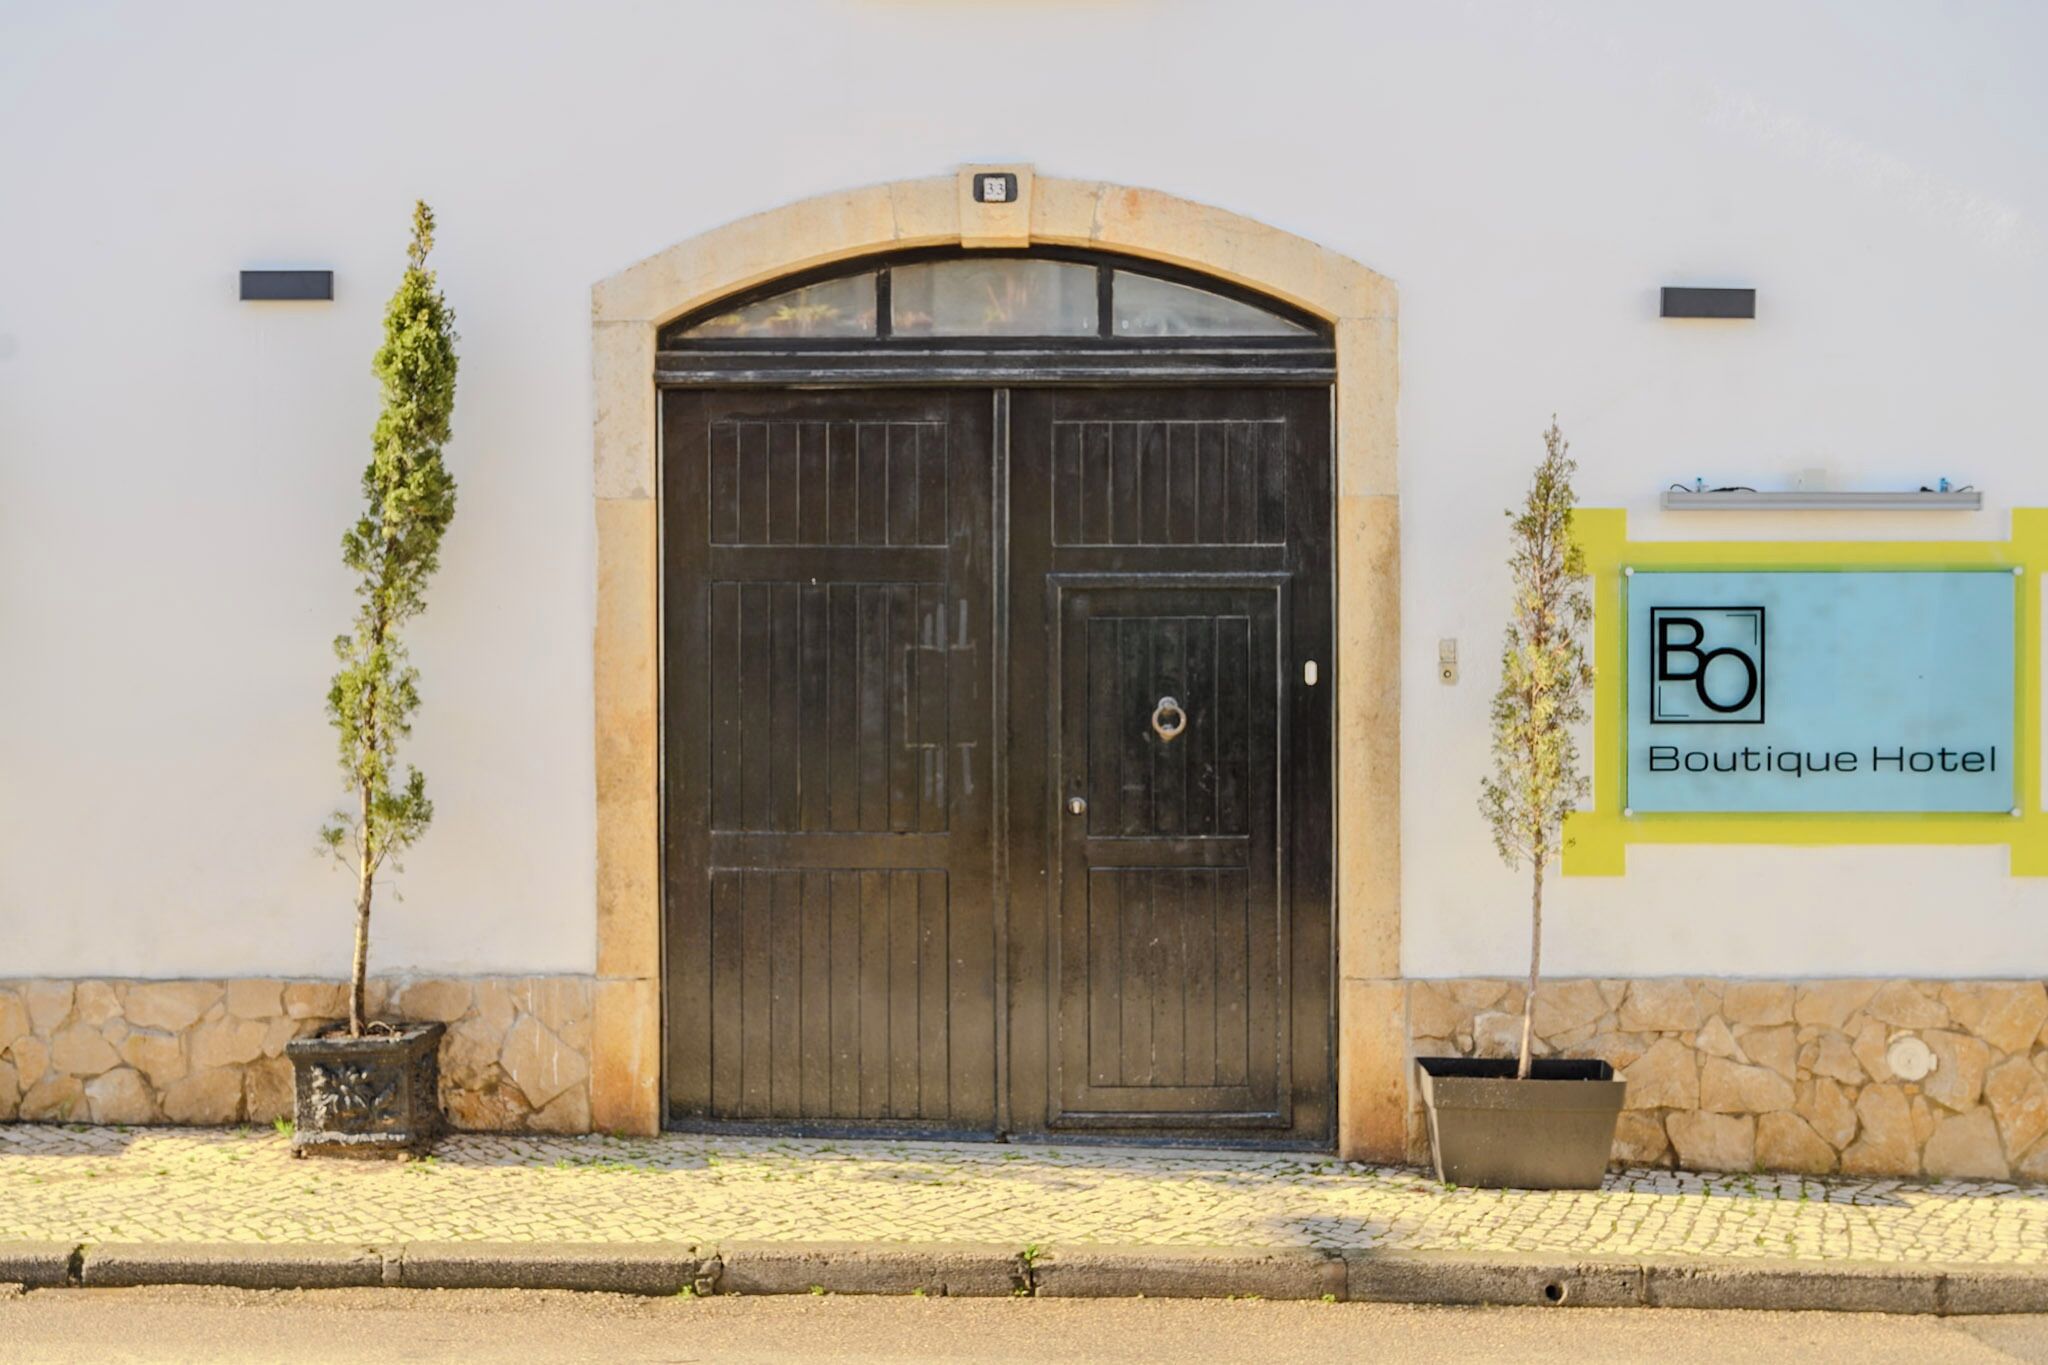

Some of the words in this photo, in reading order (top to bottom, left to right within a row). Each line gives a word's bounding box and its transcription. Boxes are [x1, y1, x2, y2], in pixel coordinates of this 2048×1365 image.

[986, 182, 1005, 196] 33
[1649, 745, 1858, 778] Boutique
[1872, 745, 1996, 773] Hotel
